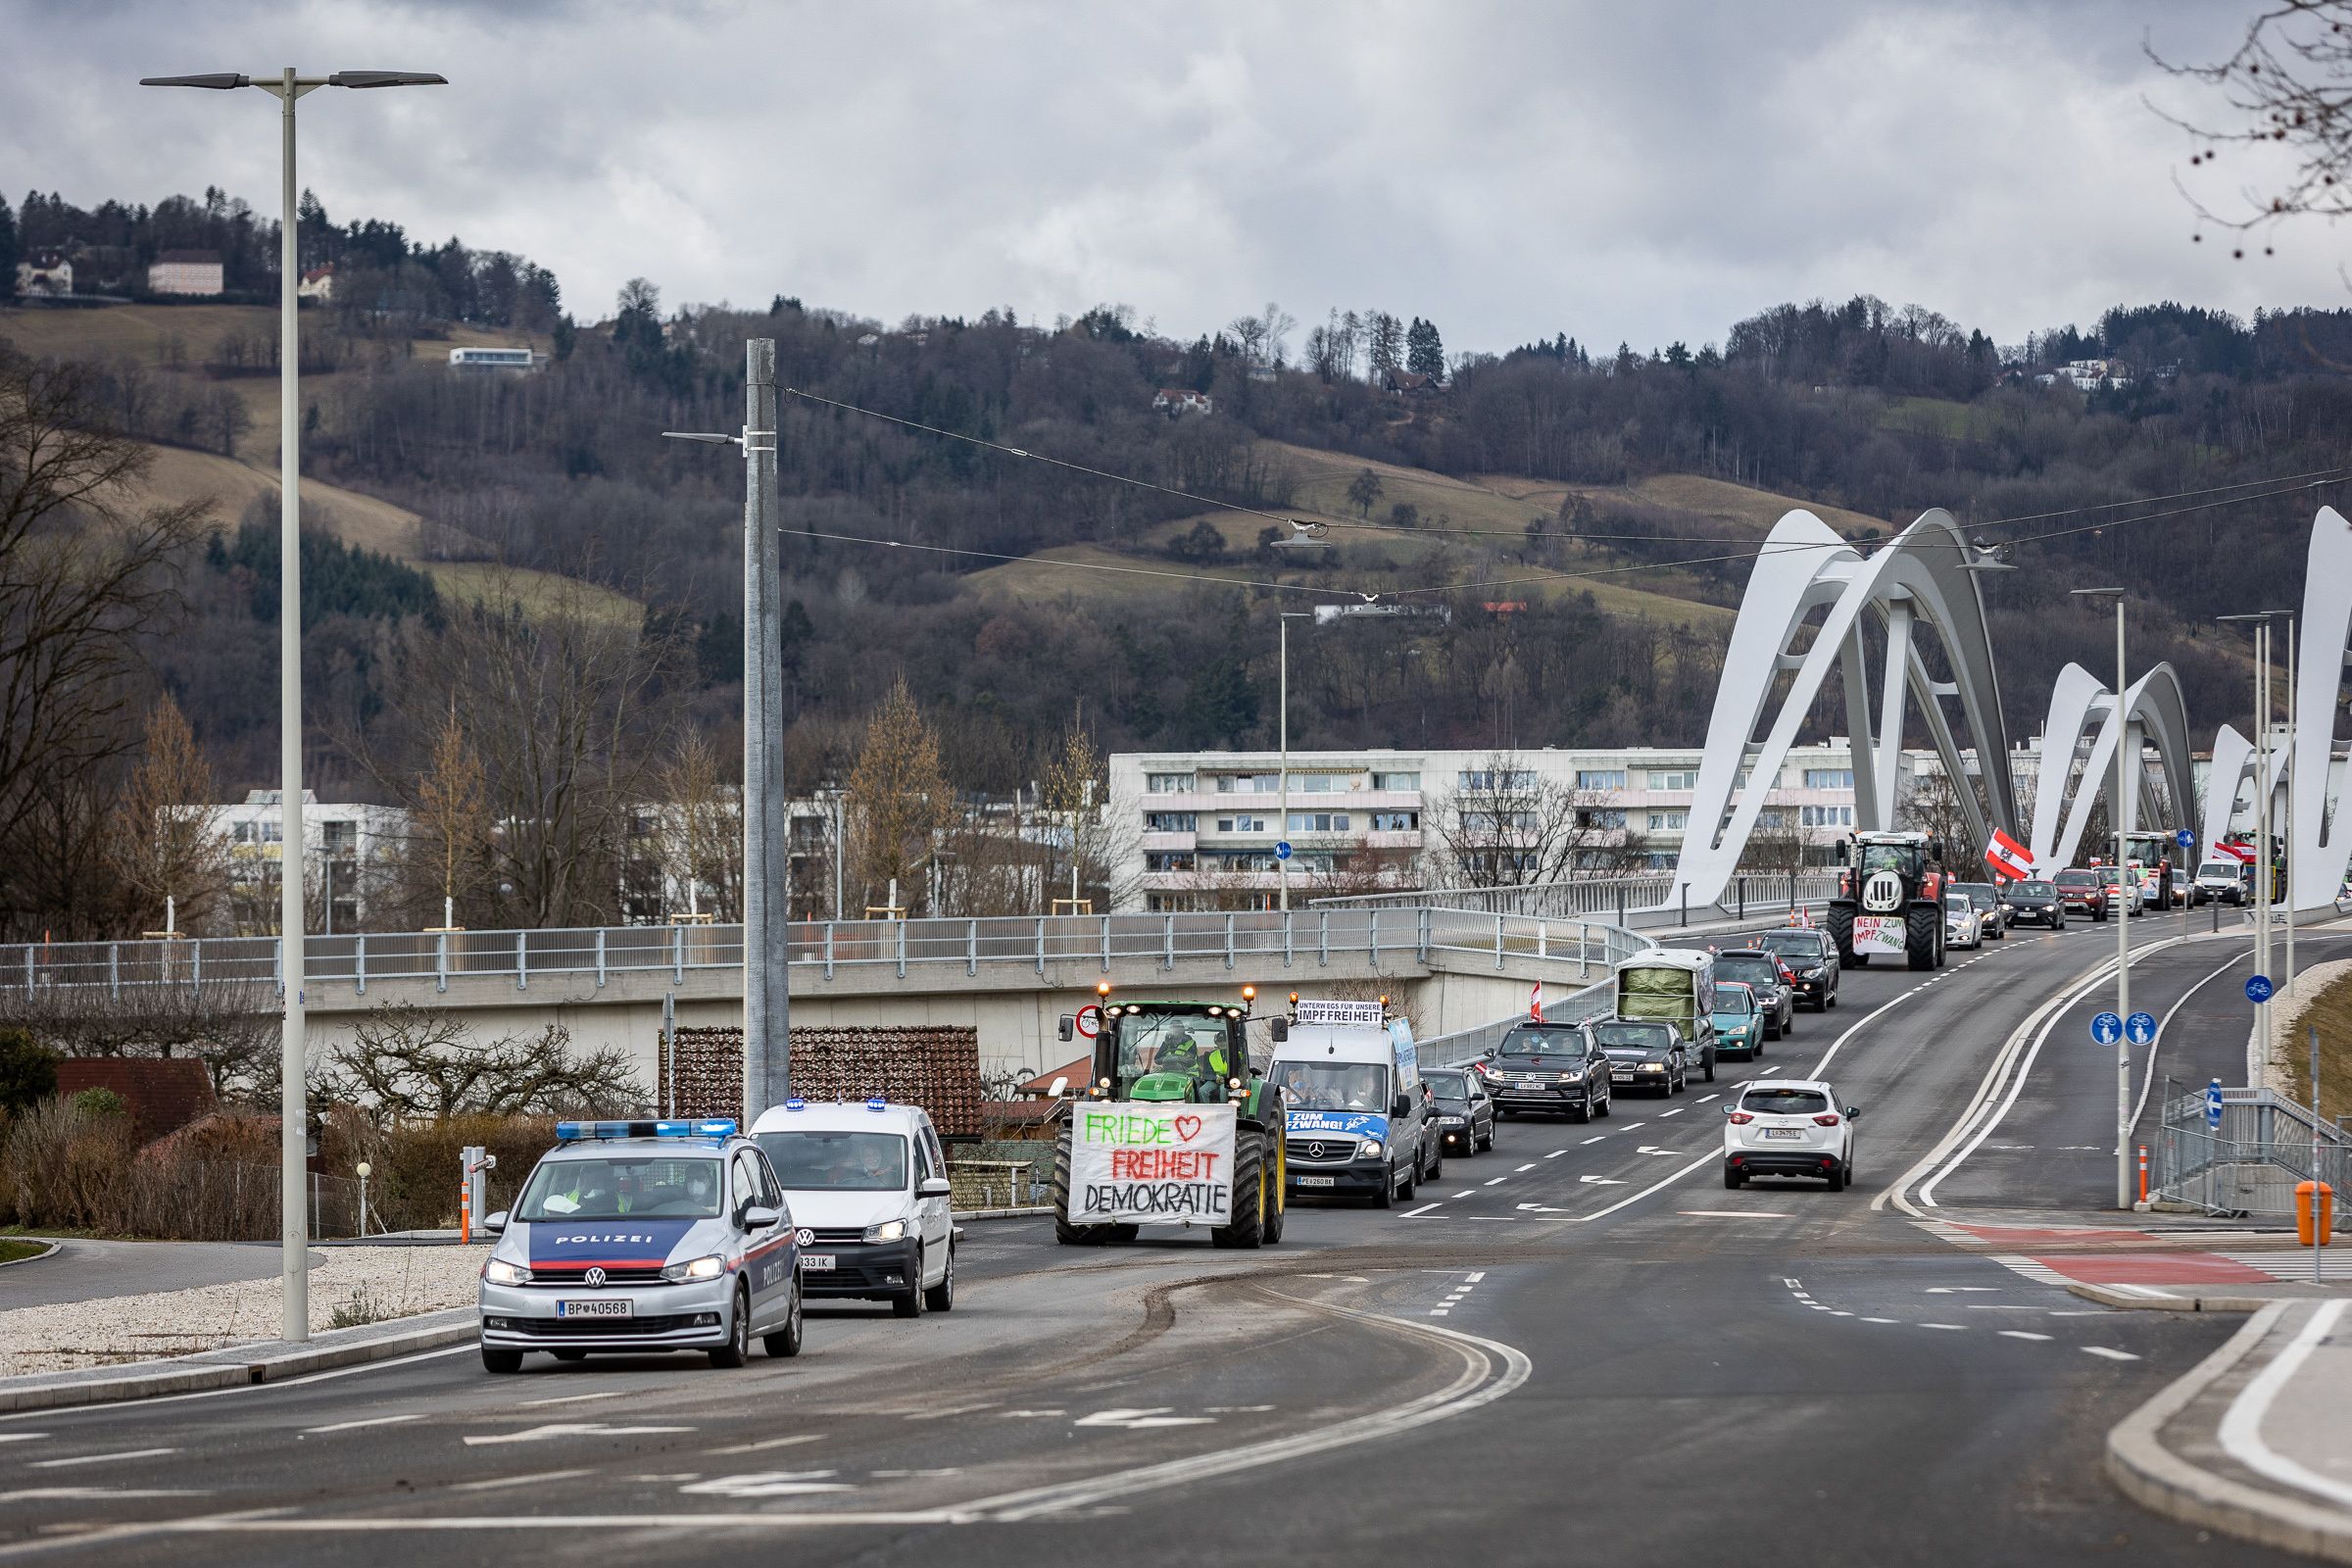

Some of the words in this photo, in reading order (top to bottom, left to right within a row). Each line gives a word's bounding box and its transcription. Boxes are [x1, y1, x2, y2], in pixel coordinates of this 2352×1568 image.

[1857, 917, 1881, 928] NEIN
[1854, 929, 1904, 950] IMPFZWANG
[1355, 1003, 1381, 1011] UNSERE
[1086, 1113, 1173, 1145] FRIEDE
[1286, 1120, 1344, 1130] FZWANG!
[1112, 1149, 1220, 1180] FREIHEIT
[1084, 1183, 1227, 1214] DEMOKRATIE
[555, 1235, 653, 1245] POLIZEI
[818, 1257, 828, 1267] IK
